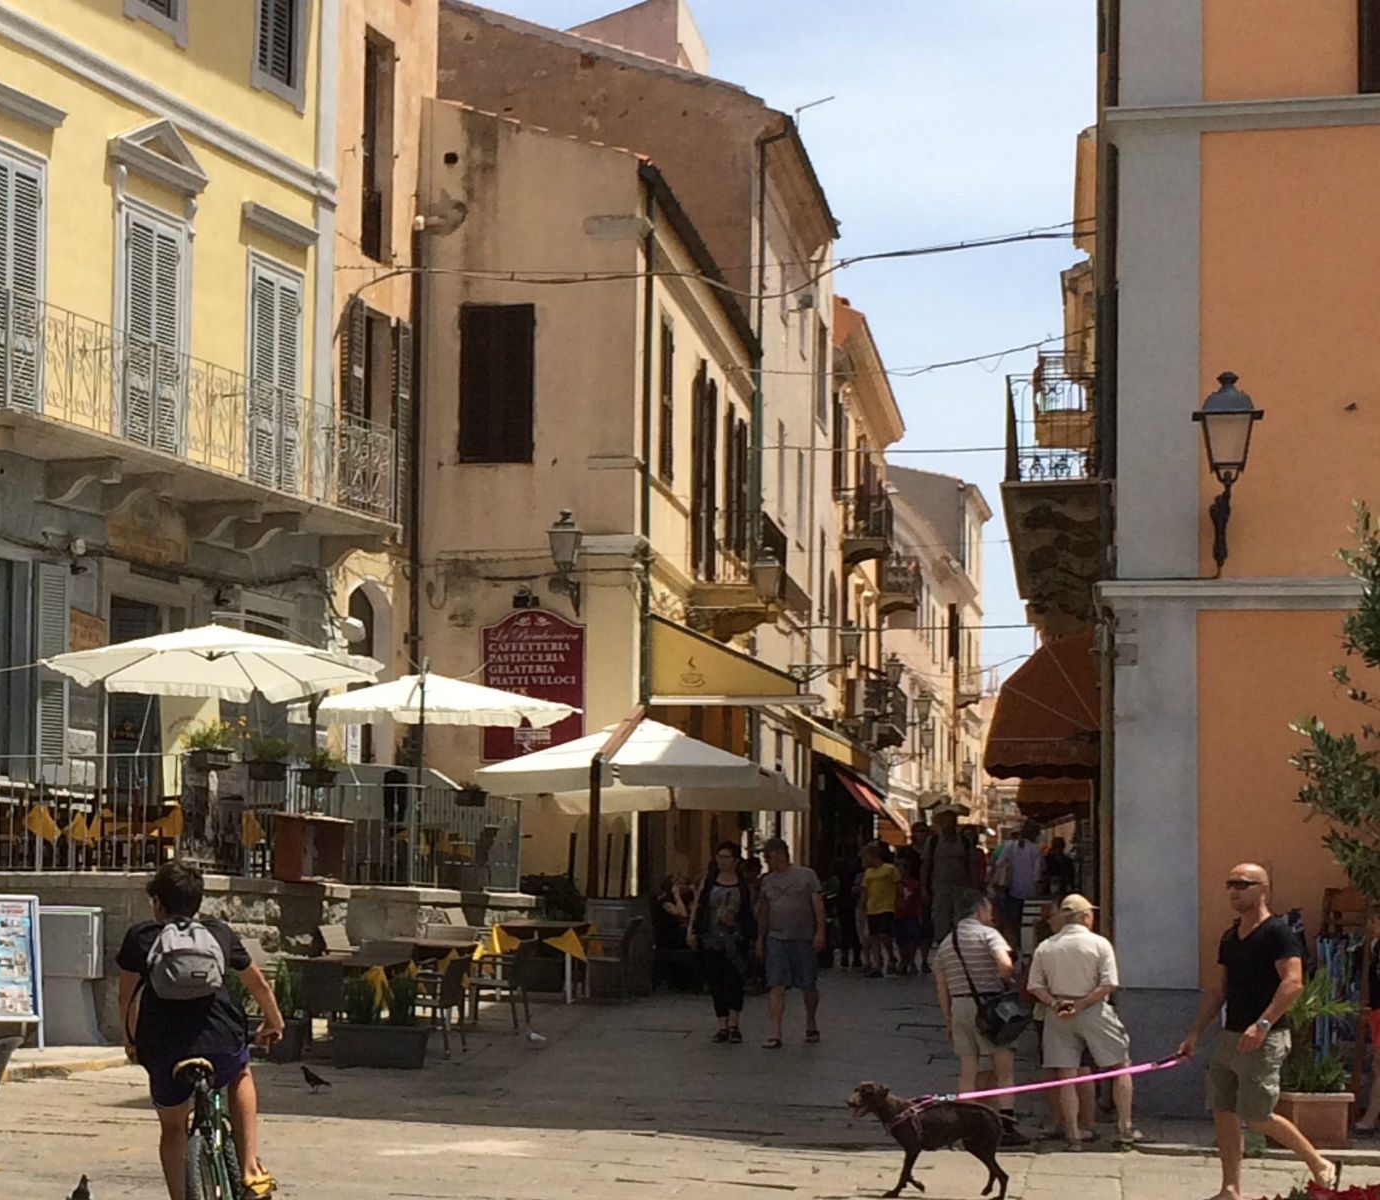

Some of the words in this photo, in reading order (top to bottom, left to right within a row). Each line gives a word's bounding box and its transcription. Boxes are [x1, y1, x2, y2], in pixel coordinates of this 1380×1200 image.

[488, 642, 571, 652] CAFFETTERIA
[488, 653, 566, 663] PASTICCERIA
[488, 664, 556, 674] GELATERIA
[489, 675, 529, 685] PIATTI
[531, 675, 577, 685] VELOCI
